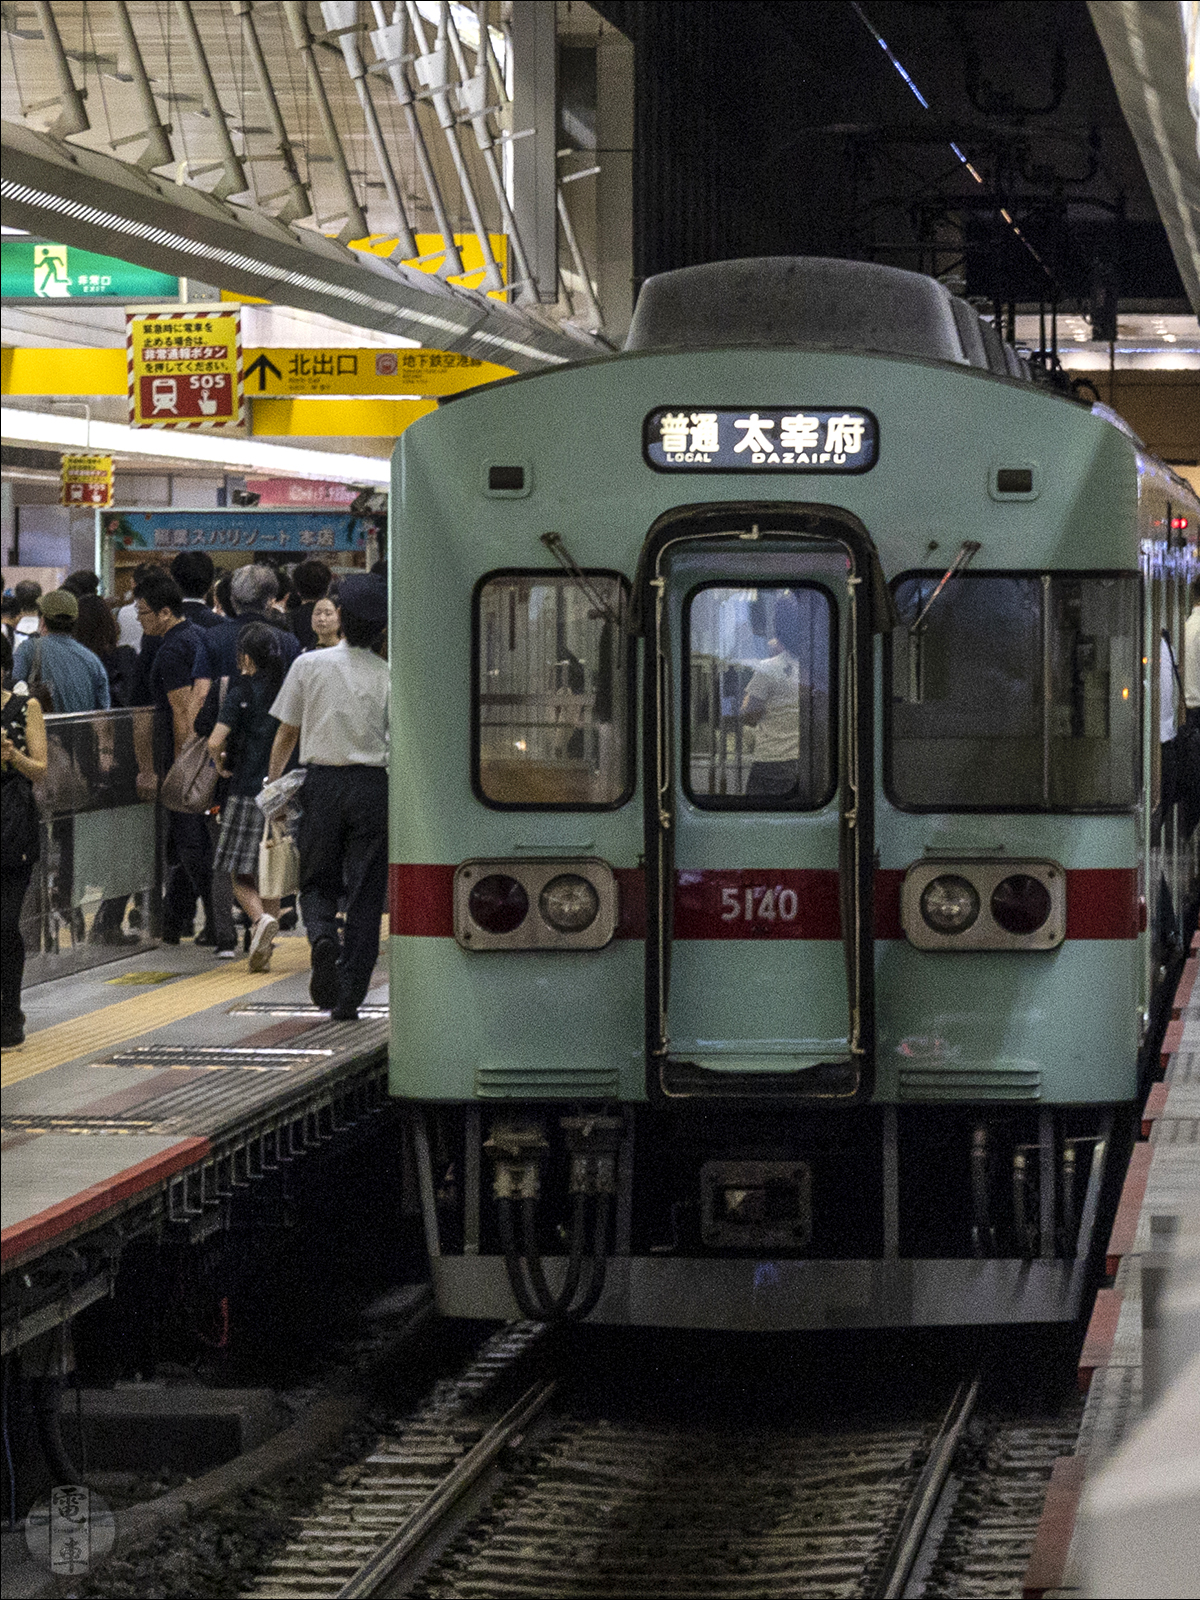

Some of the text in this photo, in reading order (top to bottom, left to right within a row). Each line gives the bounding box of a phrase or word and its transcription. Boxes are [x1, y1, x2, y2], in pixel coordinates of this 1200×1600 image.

[143, 323, 213, 334] 緊急時に電車を
[144, 347, 226, 360] 非常通報ボタン
[288, 353, 358, 376] 北出口
[189, 374, 225, 389] SOS
[660, 412, 866, 454] 普通 太宰府
[666, 453, 847, 464] LOCAL DAZAIFU
[721, 888, 798, 921] 5140
